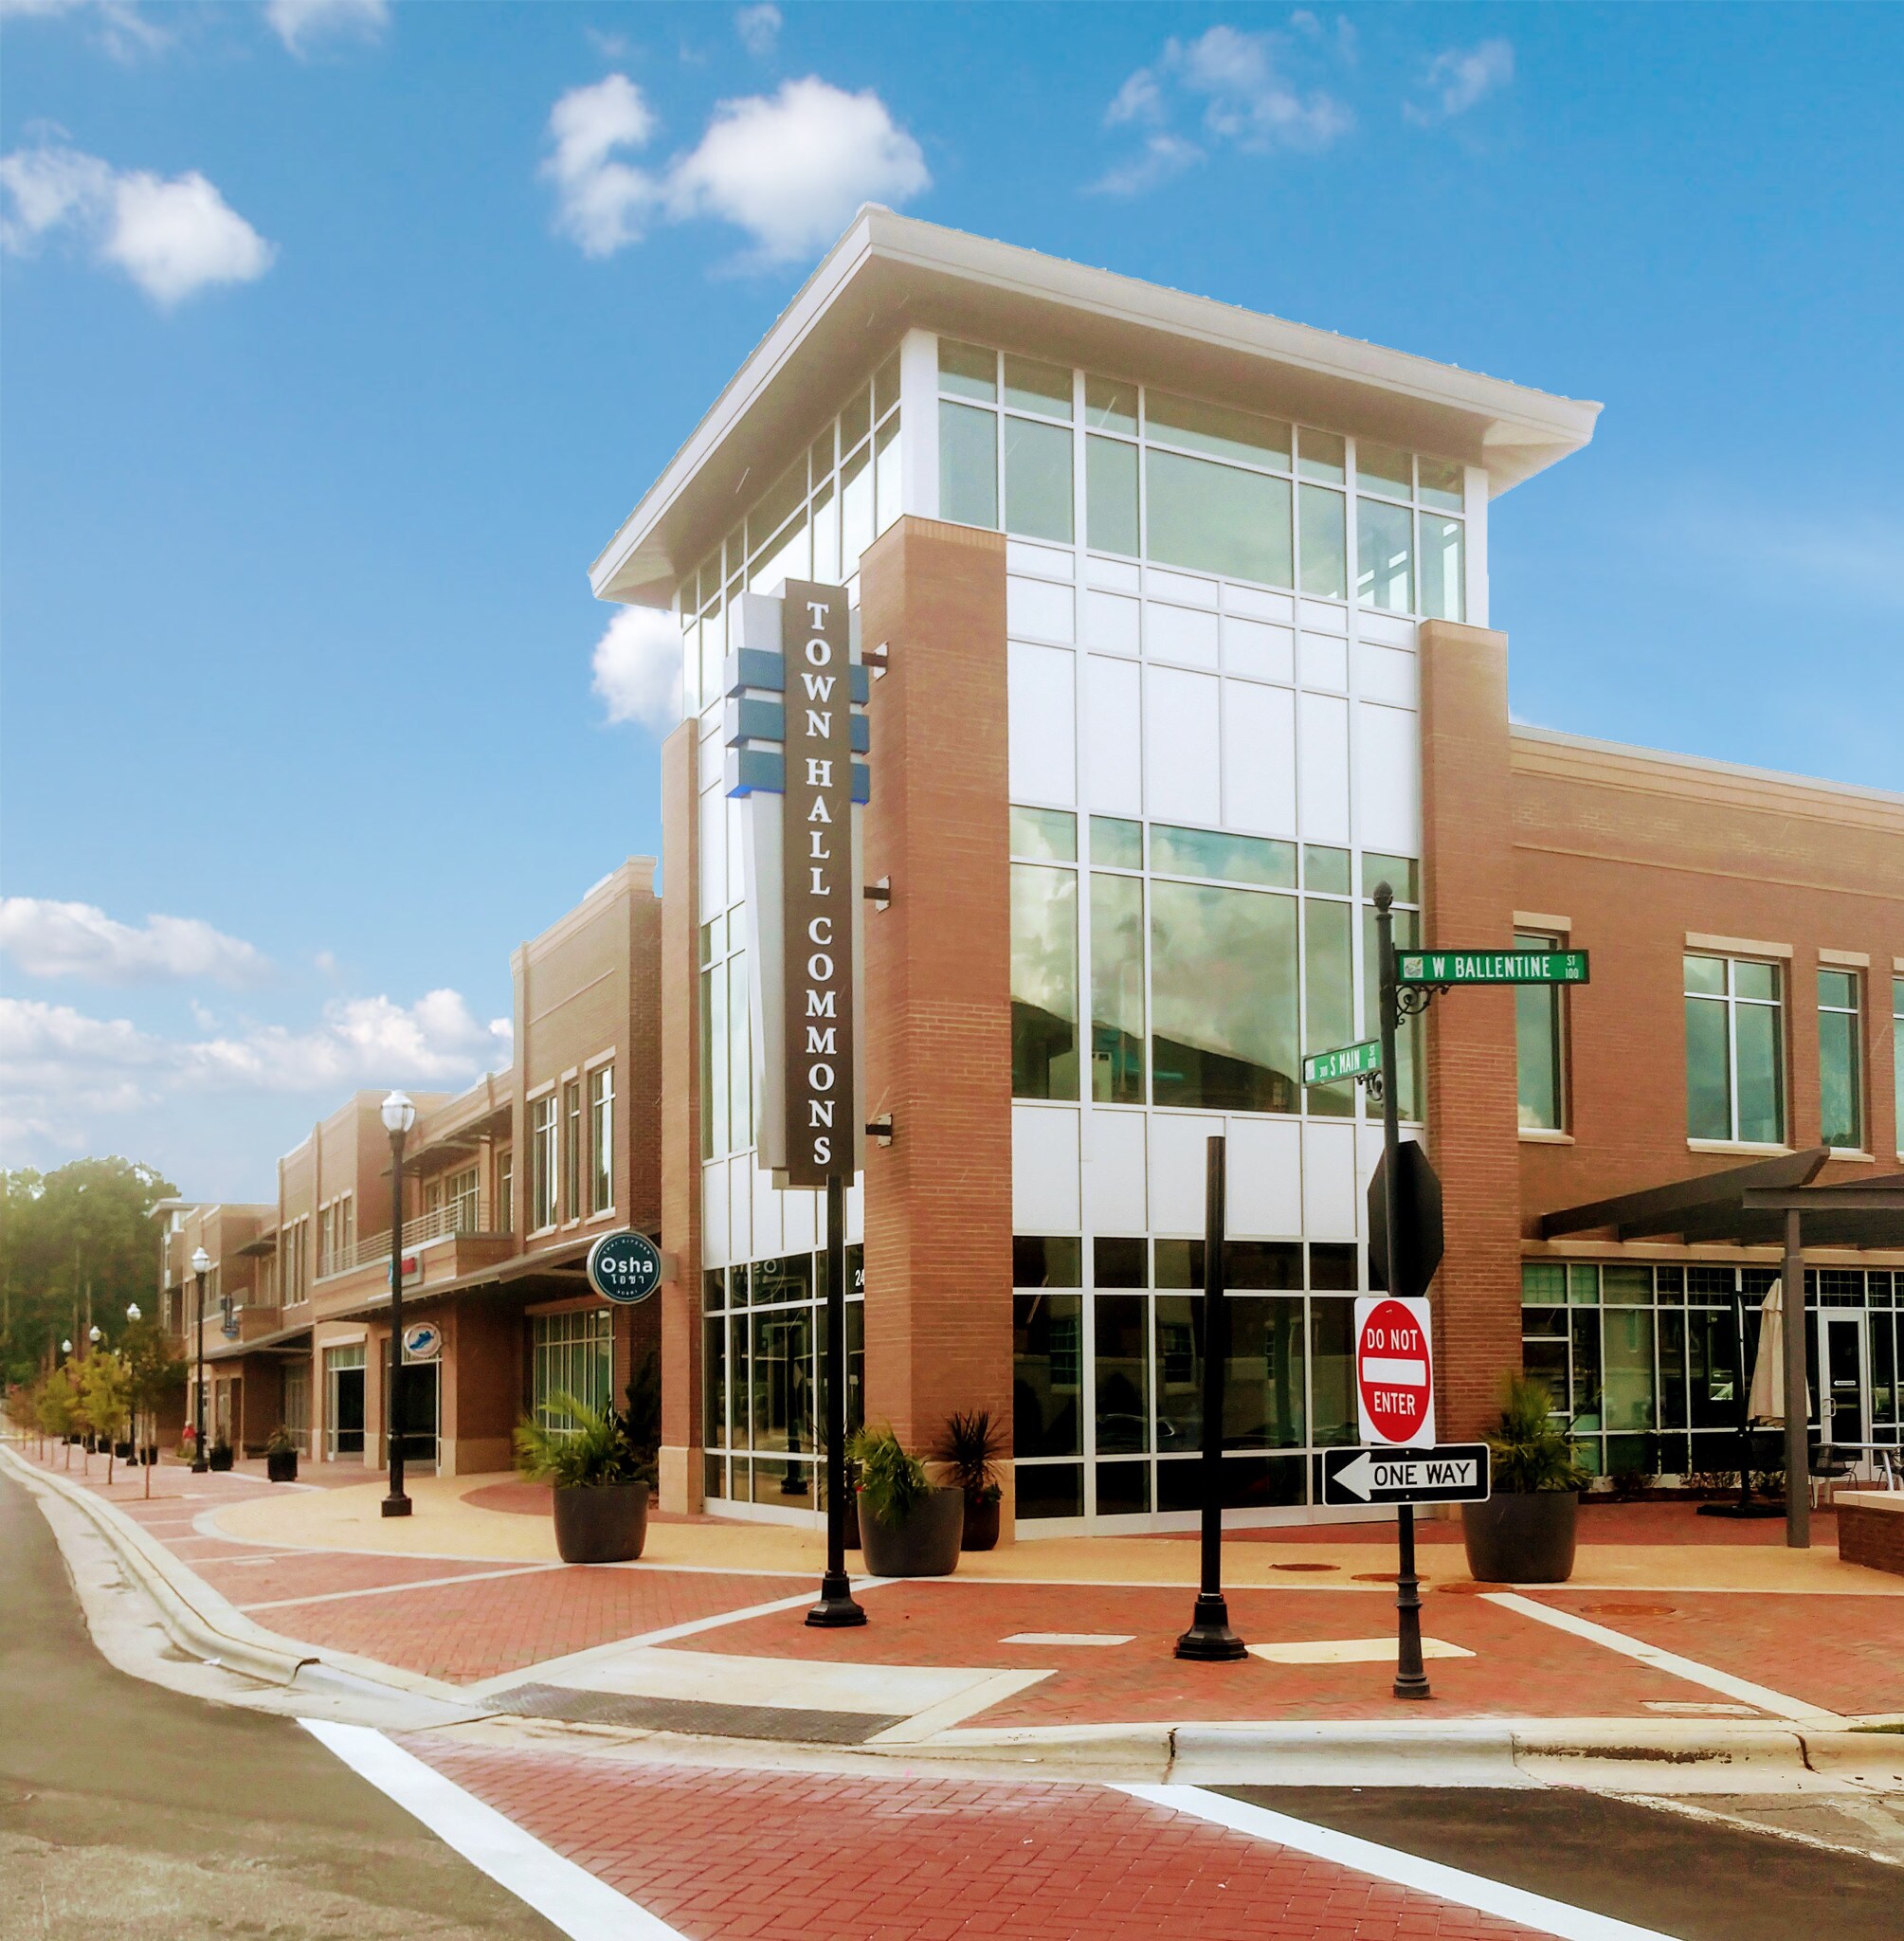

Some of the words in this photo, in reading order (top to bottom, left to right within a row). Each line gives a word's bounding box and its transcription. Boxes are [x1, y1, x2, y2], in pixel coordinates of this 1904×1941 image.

[801, 601, 836, 739] TOWN
[806, 758, 832, 896] HALL
[1432, 956, 1445, 978] W
[1455, 956, 1551, 978] BALLENTINE
[1567, 954, 1576, 966] ST
[1565, 968, 1579, 979] 100
[805, 916, 837, 1164] COMMONS
[1330, 1055, 1336, 1077] S
[1339, 1047, 1360, 1074] MAIN
[601, 1257, 653, 1273] Osha
[1366, 1328, 1385, 1350] DO
[1390, 1329, 1418, 1351] NOT
[1373, 1390, 1416, 1416] ENTER
[1373, 1463, 1418, 1486] ONE
[1425, 1462, 1471, 1484] WAY
